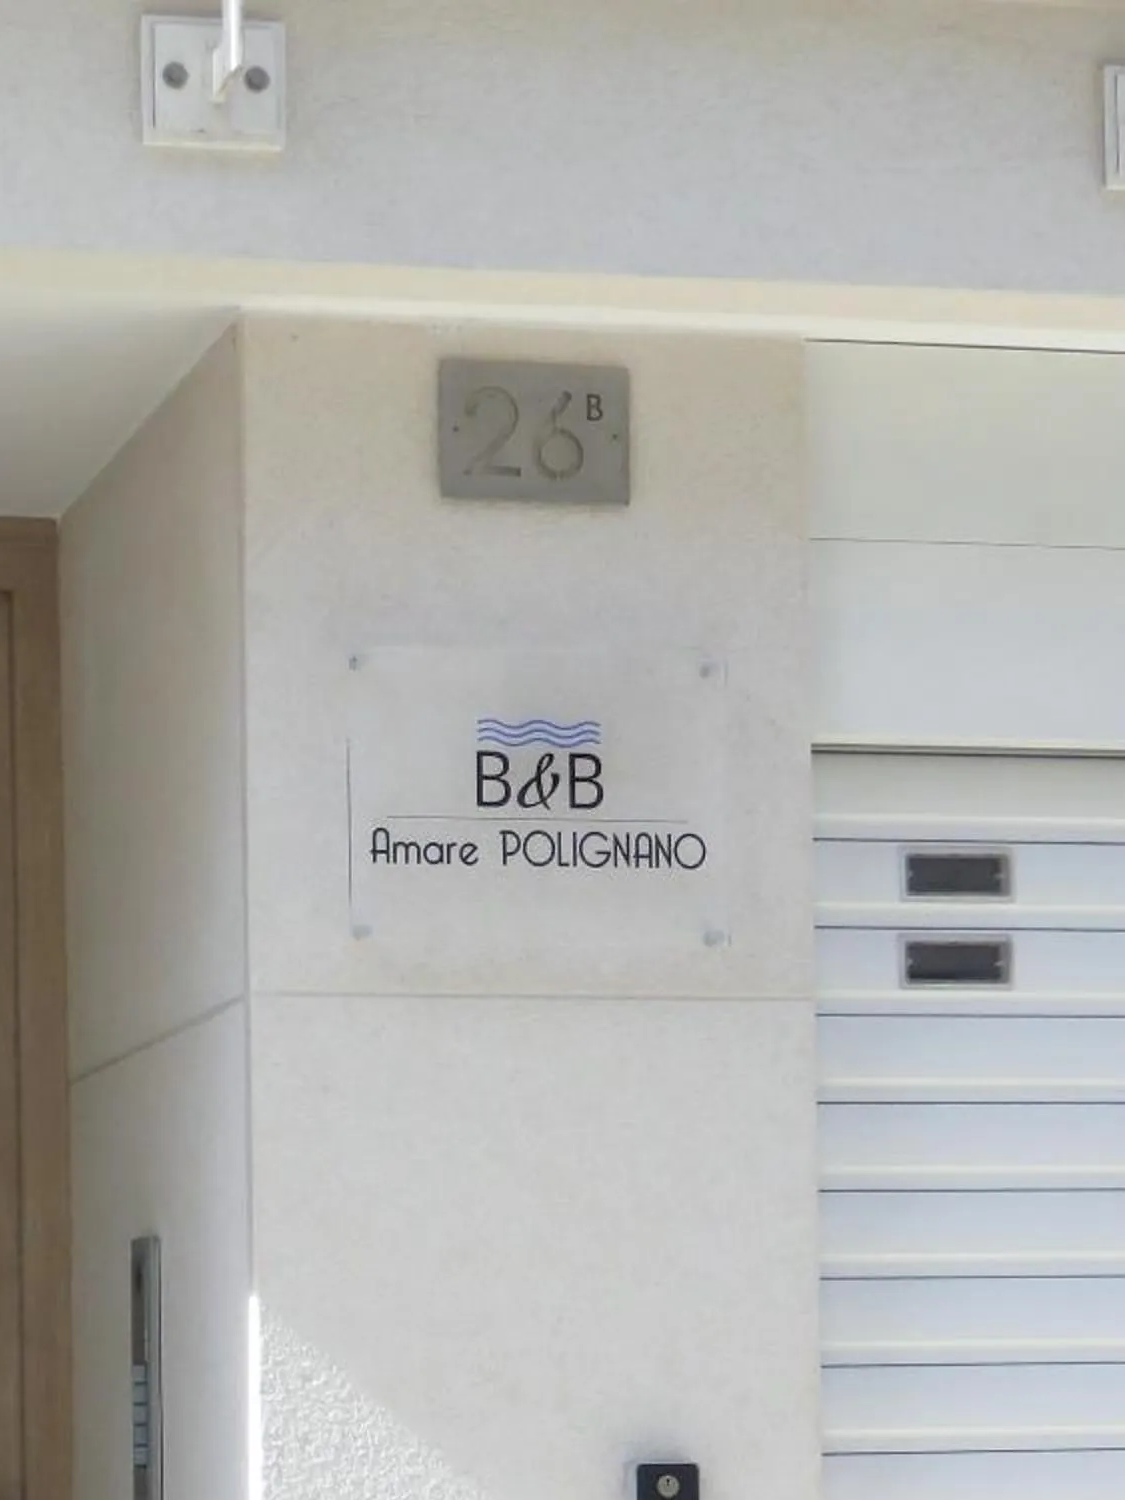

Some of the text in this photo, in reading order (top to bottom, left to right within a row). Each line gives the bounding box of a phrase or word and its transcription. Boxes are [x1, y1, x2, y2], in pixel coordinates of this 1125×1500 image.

[475, 750, 605, 810] B&B
[370, 827, 707, 869] Amare POLIGNANO
